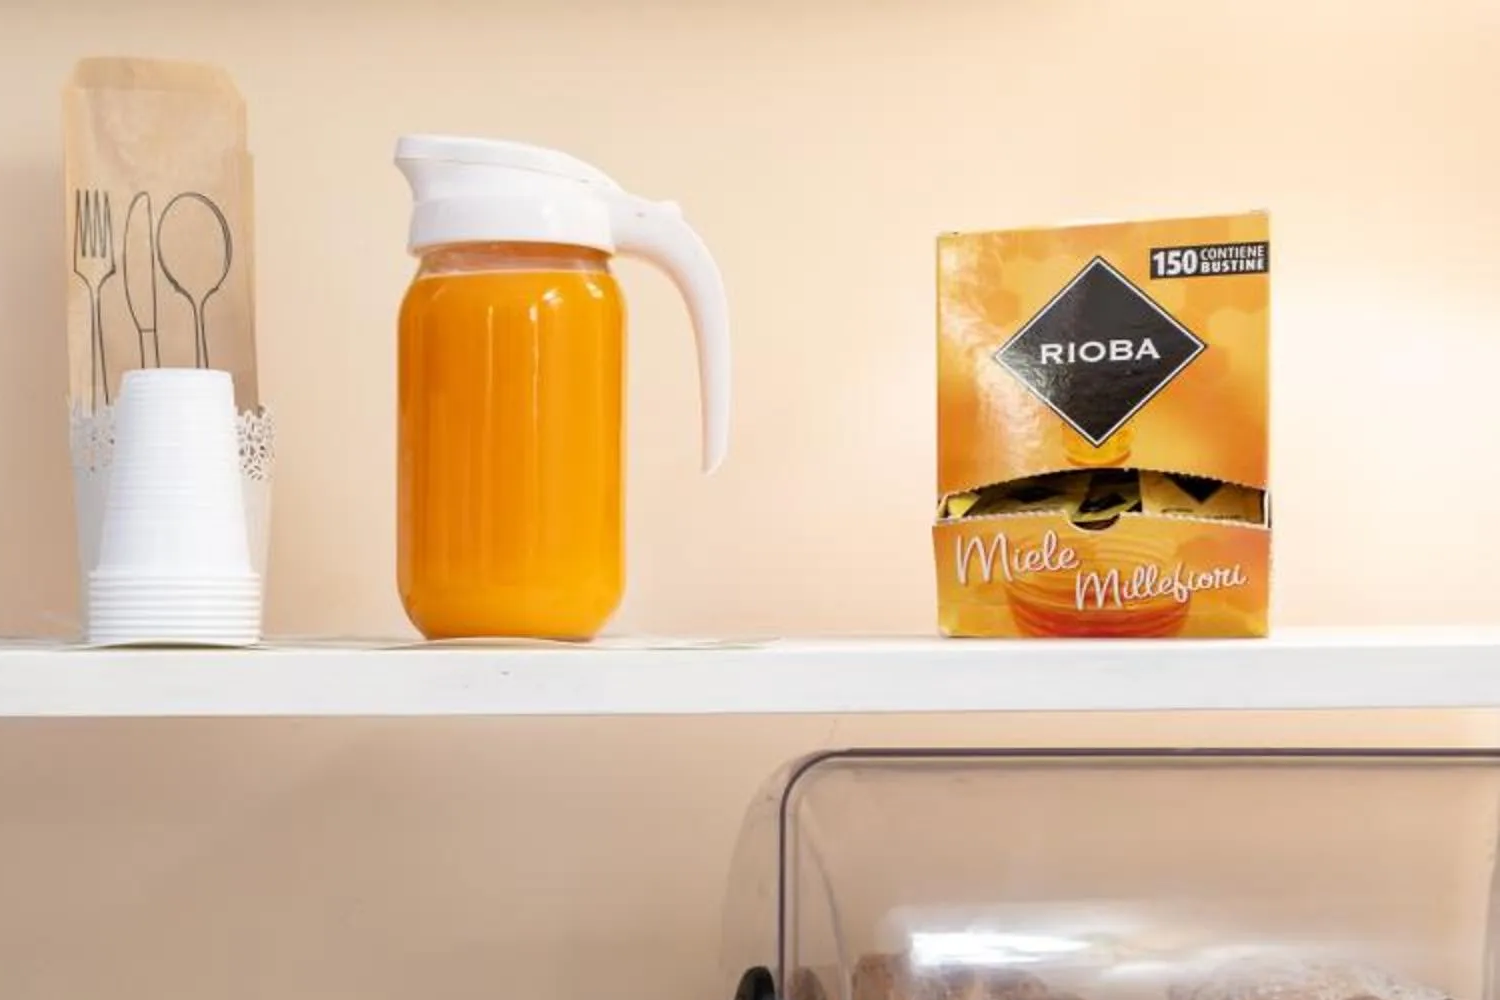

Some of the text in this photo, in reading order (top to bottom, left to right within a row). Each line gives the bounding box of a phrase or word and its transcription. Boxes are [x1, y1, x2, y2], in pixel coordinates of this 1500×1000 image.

[1152, 249, 1198, 276] 150
[1201, 246, 1265, 261] CONTIENE
[1201, 258, 1265, 273] BUSTINE
[1040, 338, 1160, 365] RIOBA
[956, 531, 1079, 585] Miele
[1075, 564, 1247, 611] Millefiori
